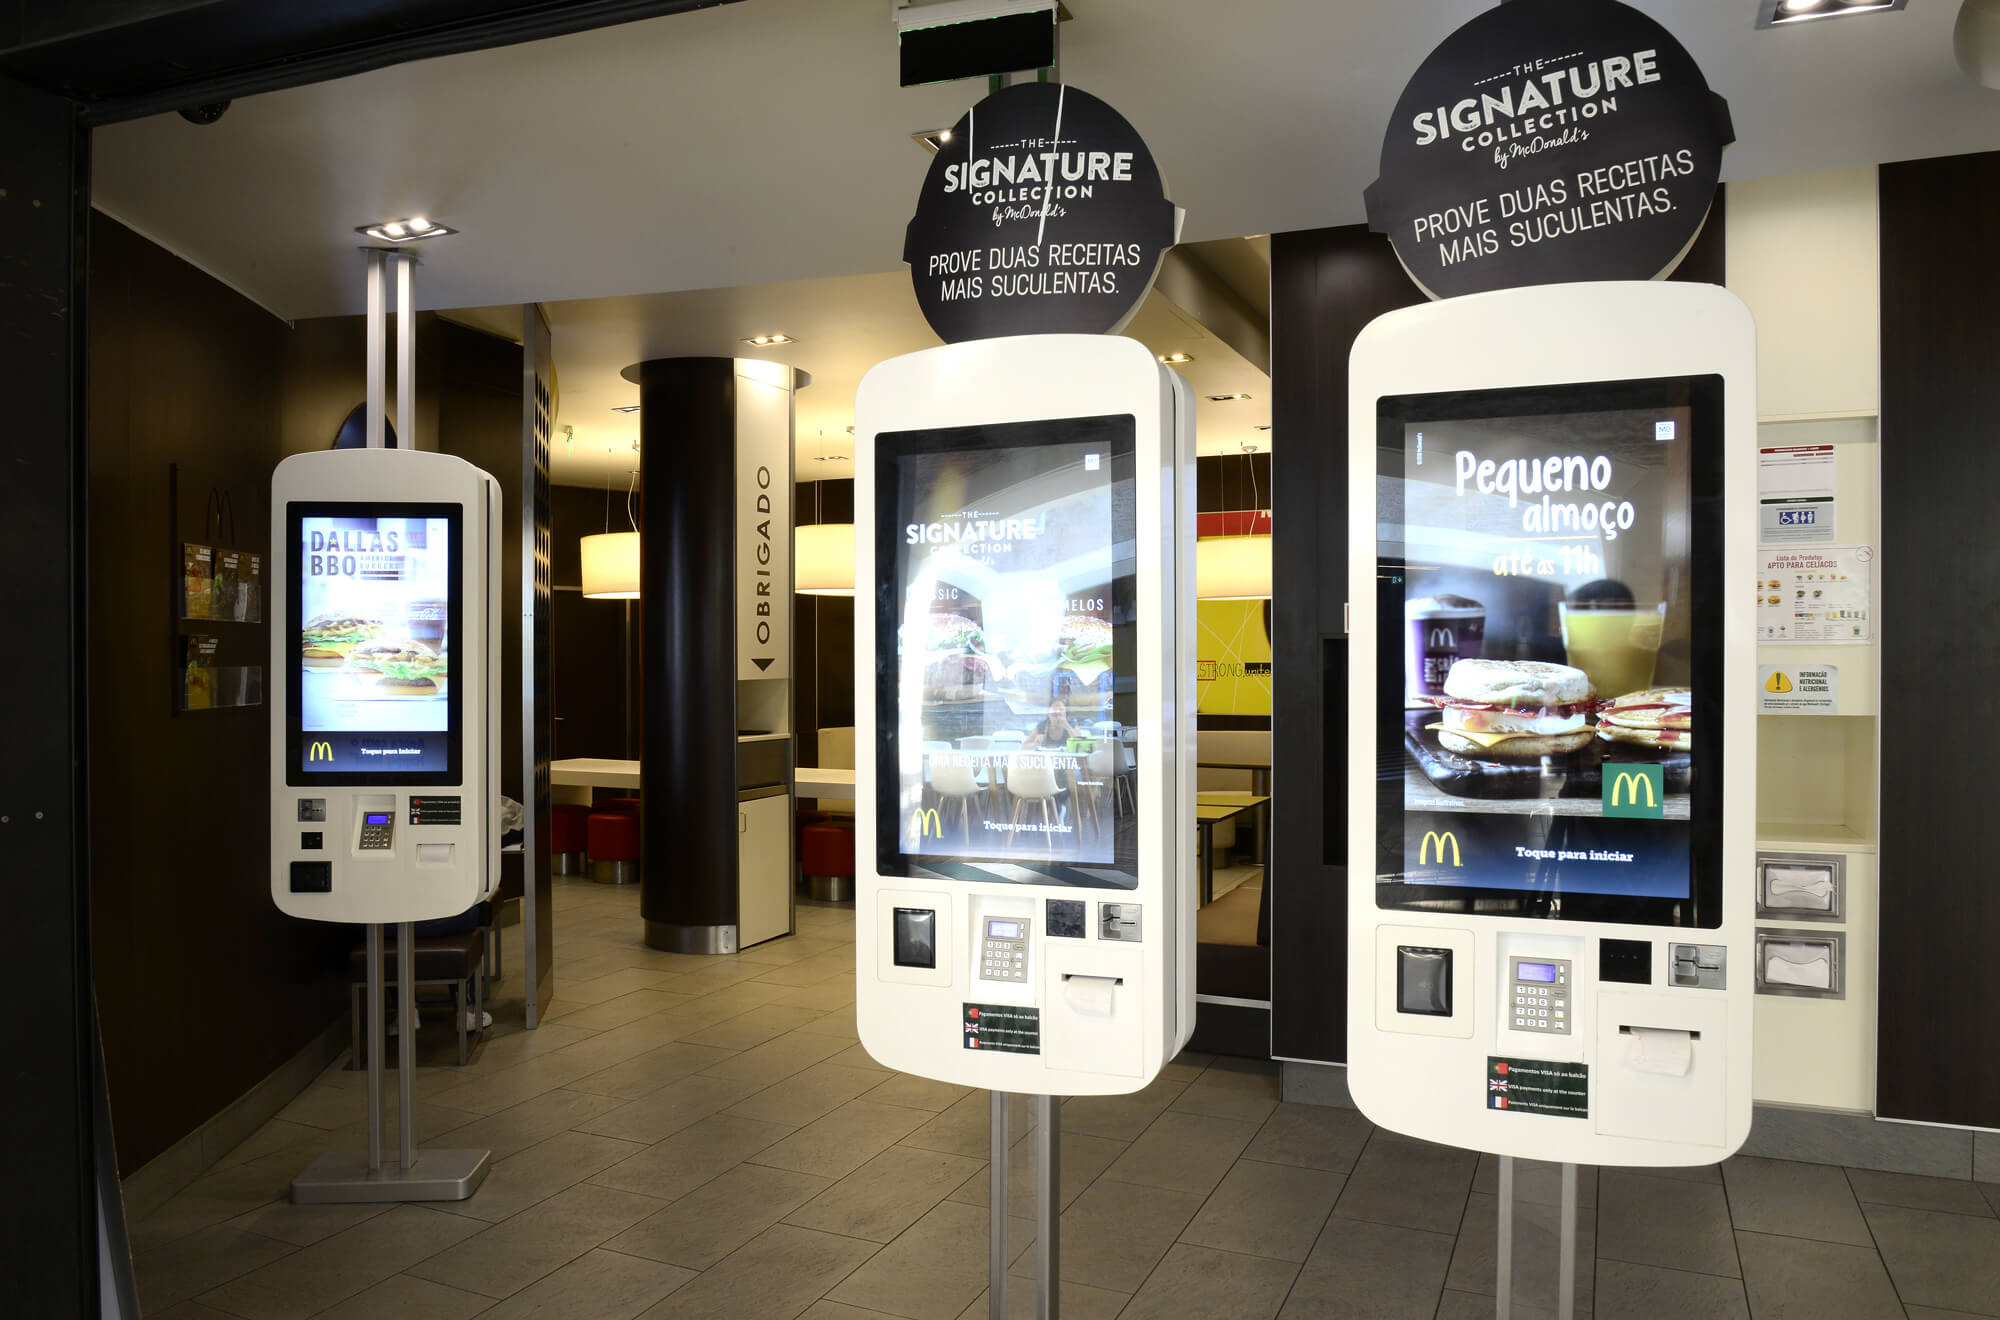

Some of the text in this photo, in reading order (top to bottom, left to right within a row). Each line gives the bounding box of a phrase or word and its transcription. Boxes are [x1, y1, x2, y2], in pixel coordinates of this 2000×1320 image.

[1513, 59, 1545, 77] THE
[1412, 49, 1661, 146] SIGNATURE
[1462, 97, 1617, 152] COLLECTION
[1020, 138, 1045, 149] THE
[1494, 129, 1590, 169] by McDonald's
[943, 152, 1133, 193] SIGNATURE
[972, 185, 1093, 206] COLLECTION
[1414, 150, 1695, 243] PROVE DUAS RECEITAS
[992, 206, 1005, 226] by
[1439, 189, 1677, 267] MAIS SUCULENTAS.
[929, 244, 1140, 277] PROVE DUAS RECEITAS
[941, 271, 1120, 302] MAIS SUCULENTAS.
[1455, 450, 1612, 508] Pequeno
[961, 511, 978, 519] THE
[1522, 495, 1635, 541] almoço
[311, 531, 398, 552] DALLAS
[905, 519, 1036, 545] SIGNATURE
[756, 465, 770, 645] OBRIGADO
[1494, 547, 1534, 577] até
[1558, 544, 1599, 576] 11h
[984, 821, 1073, 833] Toque para iniciar
[1515, 846, 1634, 863] Toque para iniciar
[1541, 1067, 1553, 1076] VISA
